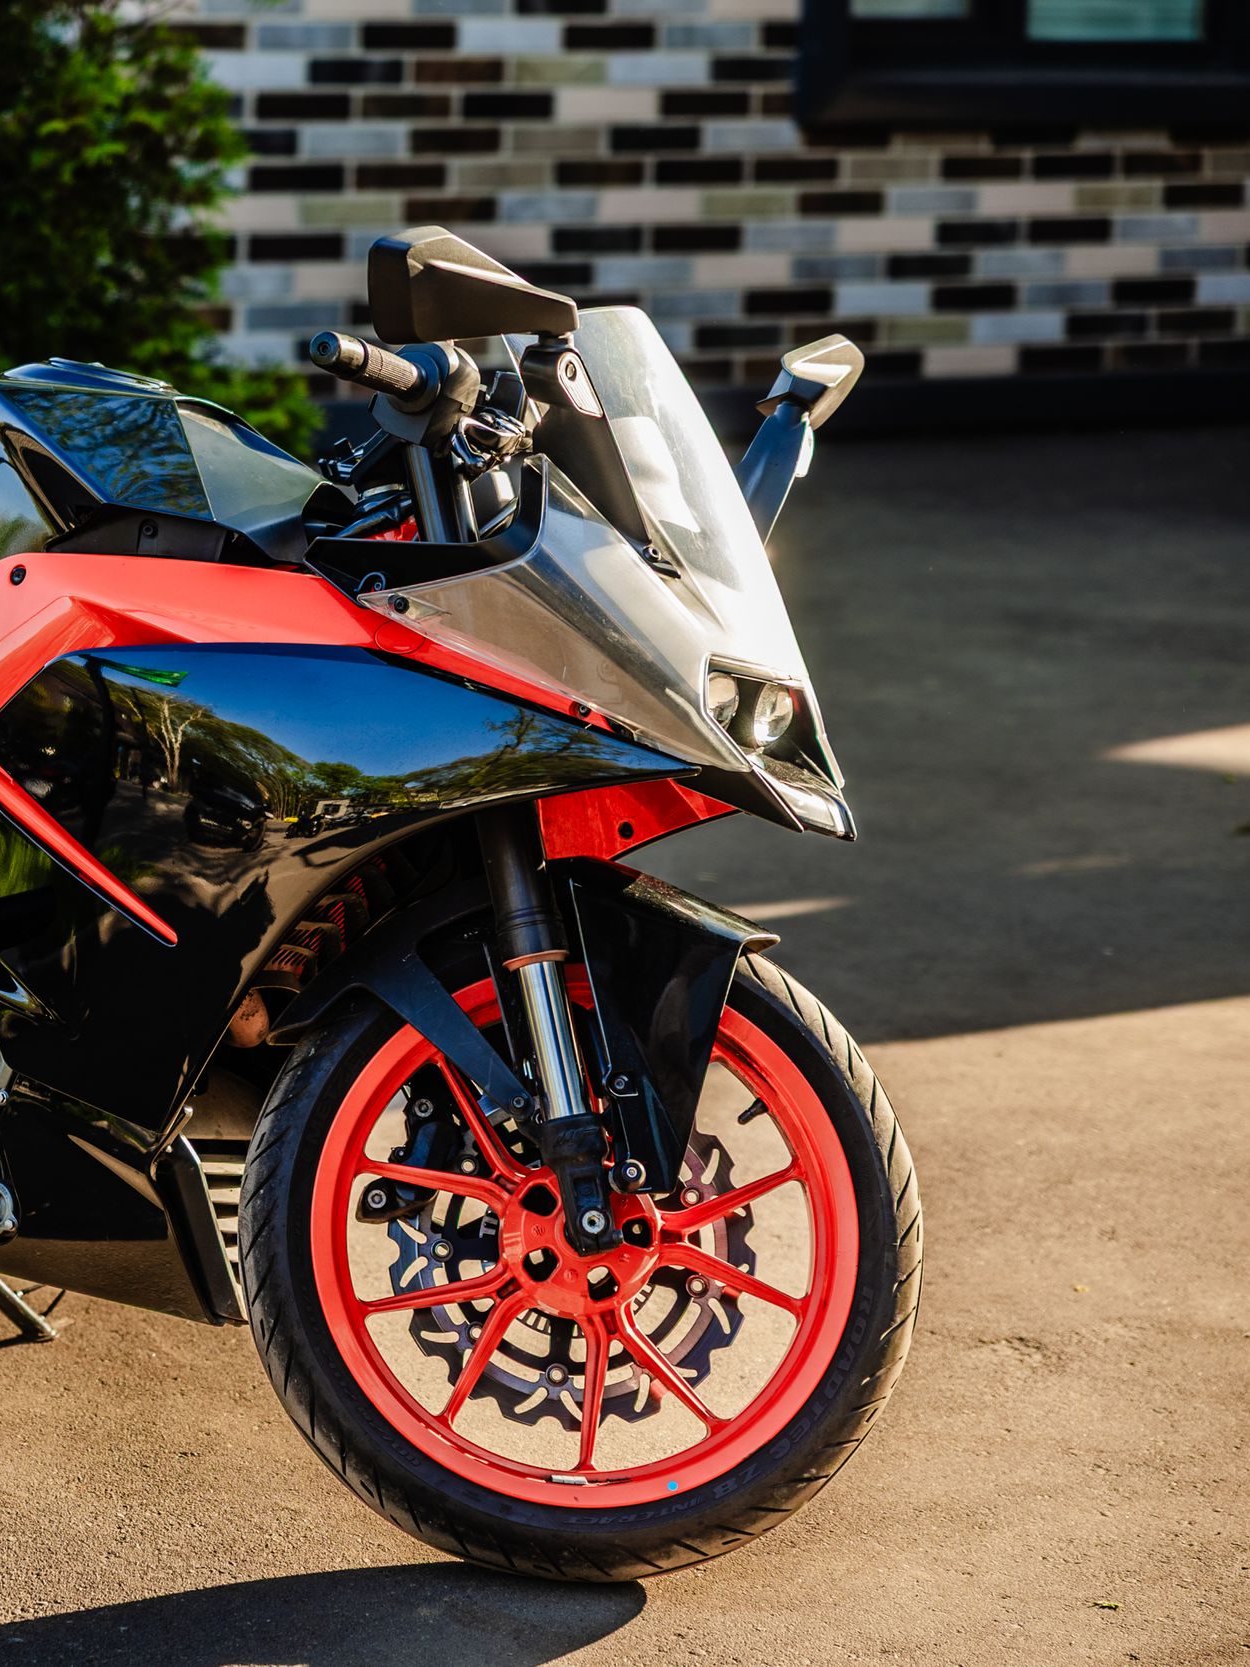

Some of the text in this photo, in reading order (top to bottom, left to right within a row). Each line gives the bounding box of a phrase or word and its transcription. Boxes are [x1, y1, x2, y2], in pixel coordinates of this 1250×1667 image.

[563, 1286, 875, 1525] ROADTEC Z8 INTERACT
